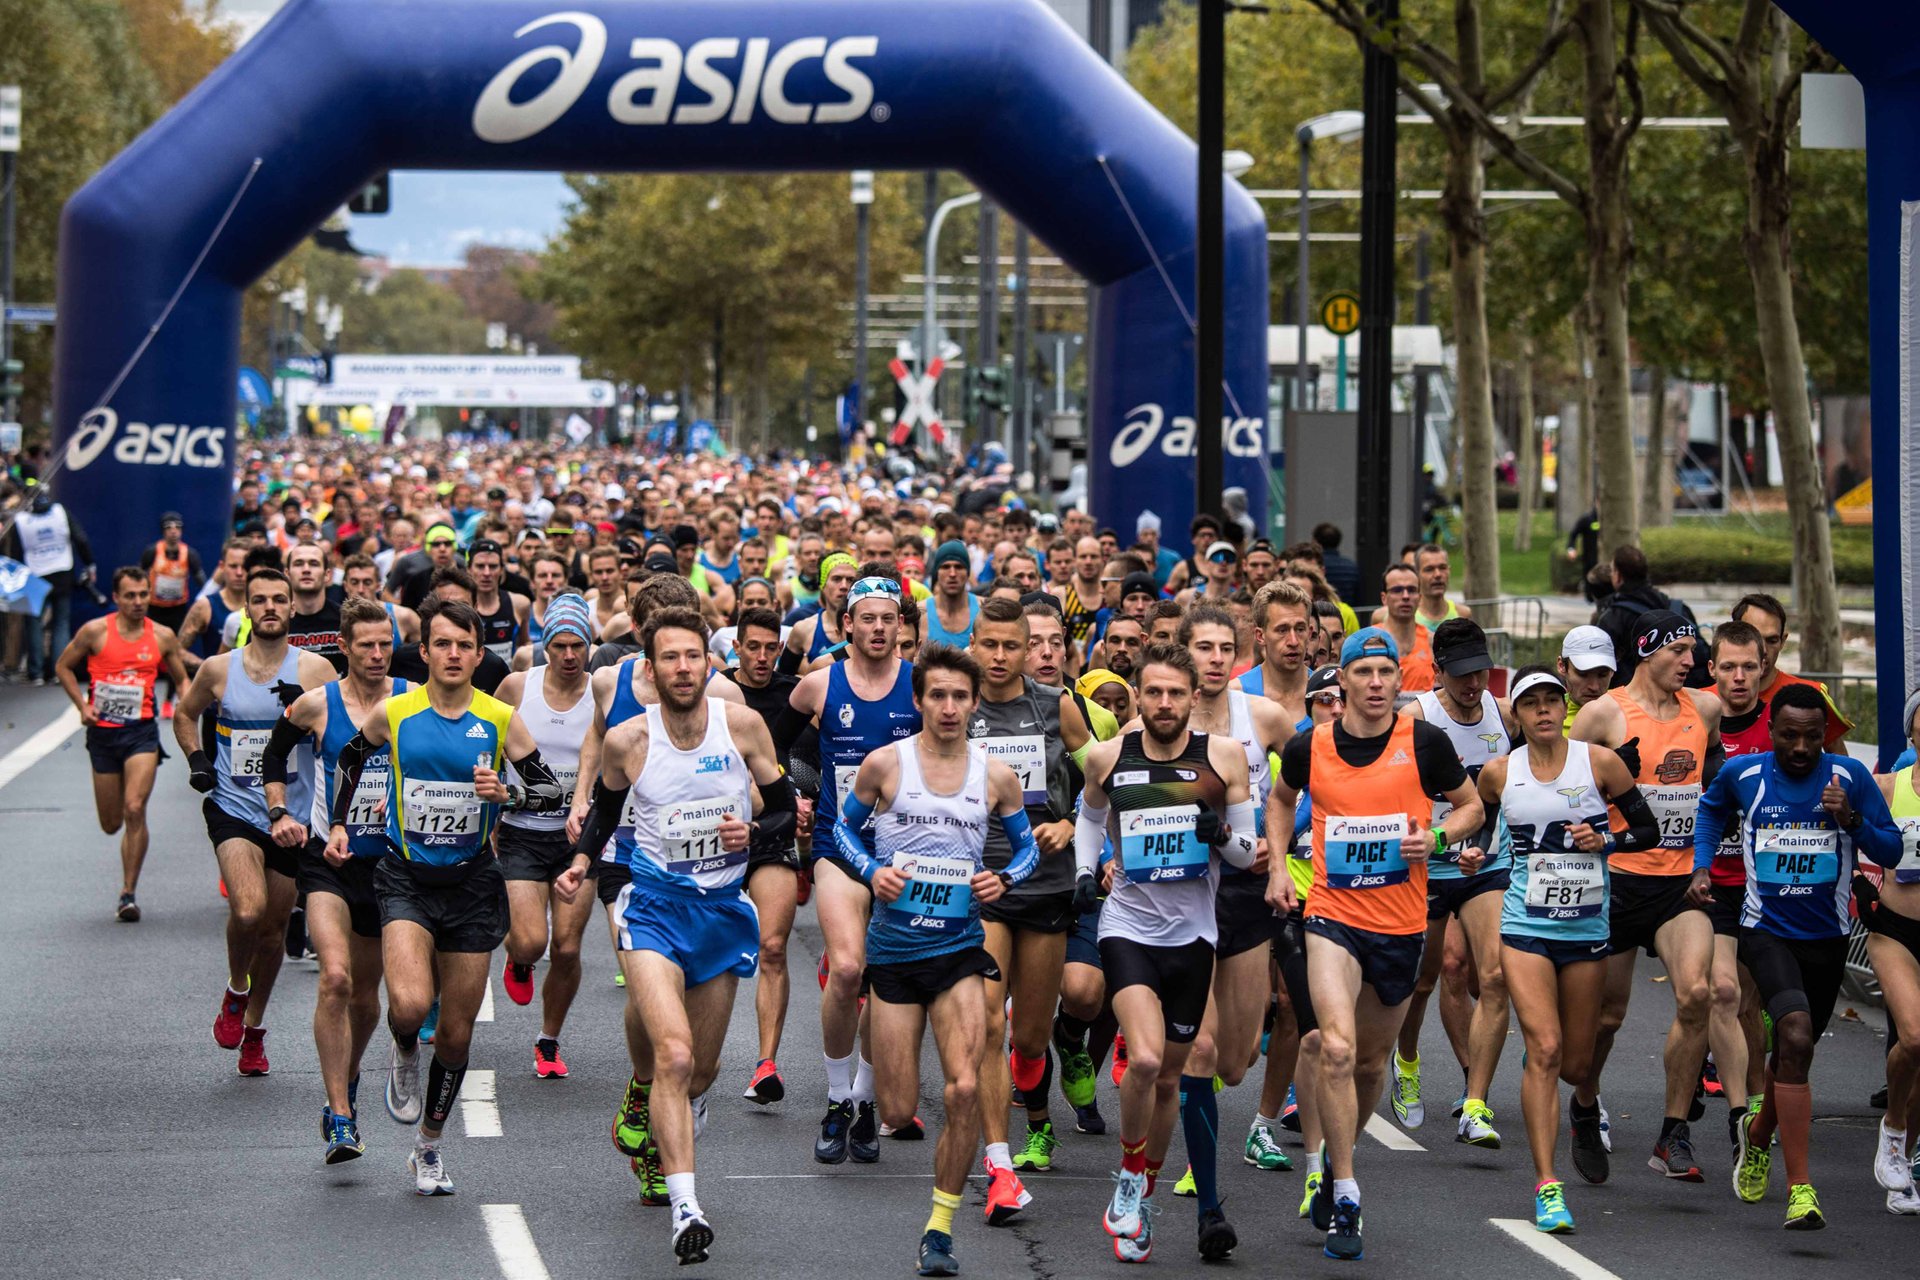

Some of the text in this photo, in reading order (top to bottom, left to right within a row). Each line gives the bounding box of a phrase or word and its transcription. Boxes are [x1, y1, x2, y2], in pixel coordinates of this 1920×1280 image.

[1161, 416, 1263, 457] aics
[988, 743, 1037, 754] mainova
[357, 779, 385, 789] main
[425, 788, 474, 799] mainova
[1657, 791, 1698, 801] mainova
[429, 805, 456, 814] Tommi
[683, 804, 735, 821] mainova
[1665, 809, 1680, 817] Dan
[1761, 805, 1789, 814] HEITEC
[417, 814, 468, 833] 1124
[909, 815, 939, 825] TELIS
[1144, 813, 1198, 827] mainova
[1655, 816, 1694, 835] 139
[1347, 823, 1400, 835] mainova
[681, 836, 720, 859] 111
[1143, 832, 1185, 857] PACE
[1778, 836, 1830, 847] mainova
[1346, 841, 1388, 863] PACE
[917, 863, 967, 877] mainova
[1546, 860, 1595, 870] mainova
[1776, 853, 1818, 874] PACE
[1538, 877, 1590, 887] Maria grazzia
[909, 881, 954, 906] PACE
[1544, 887, 1584, 905] F81
